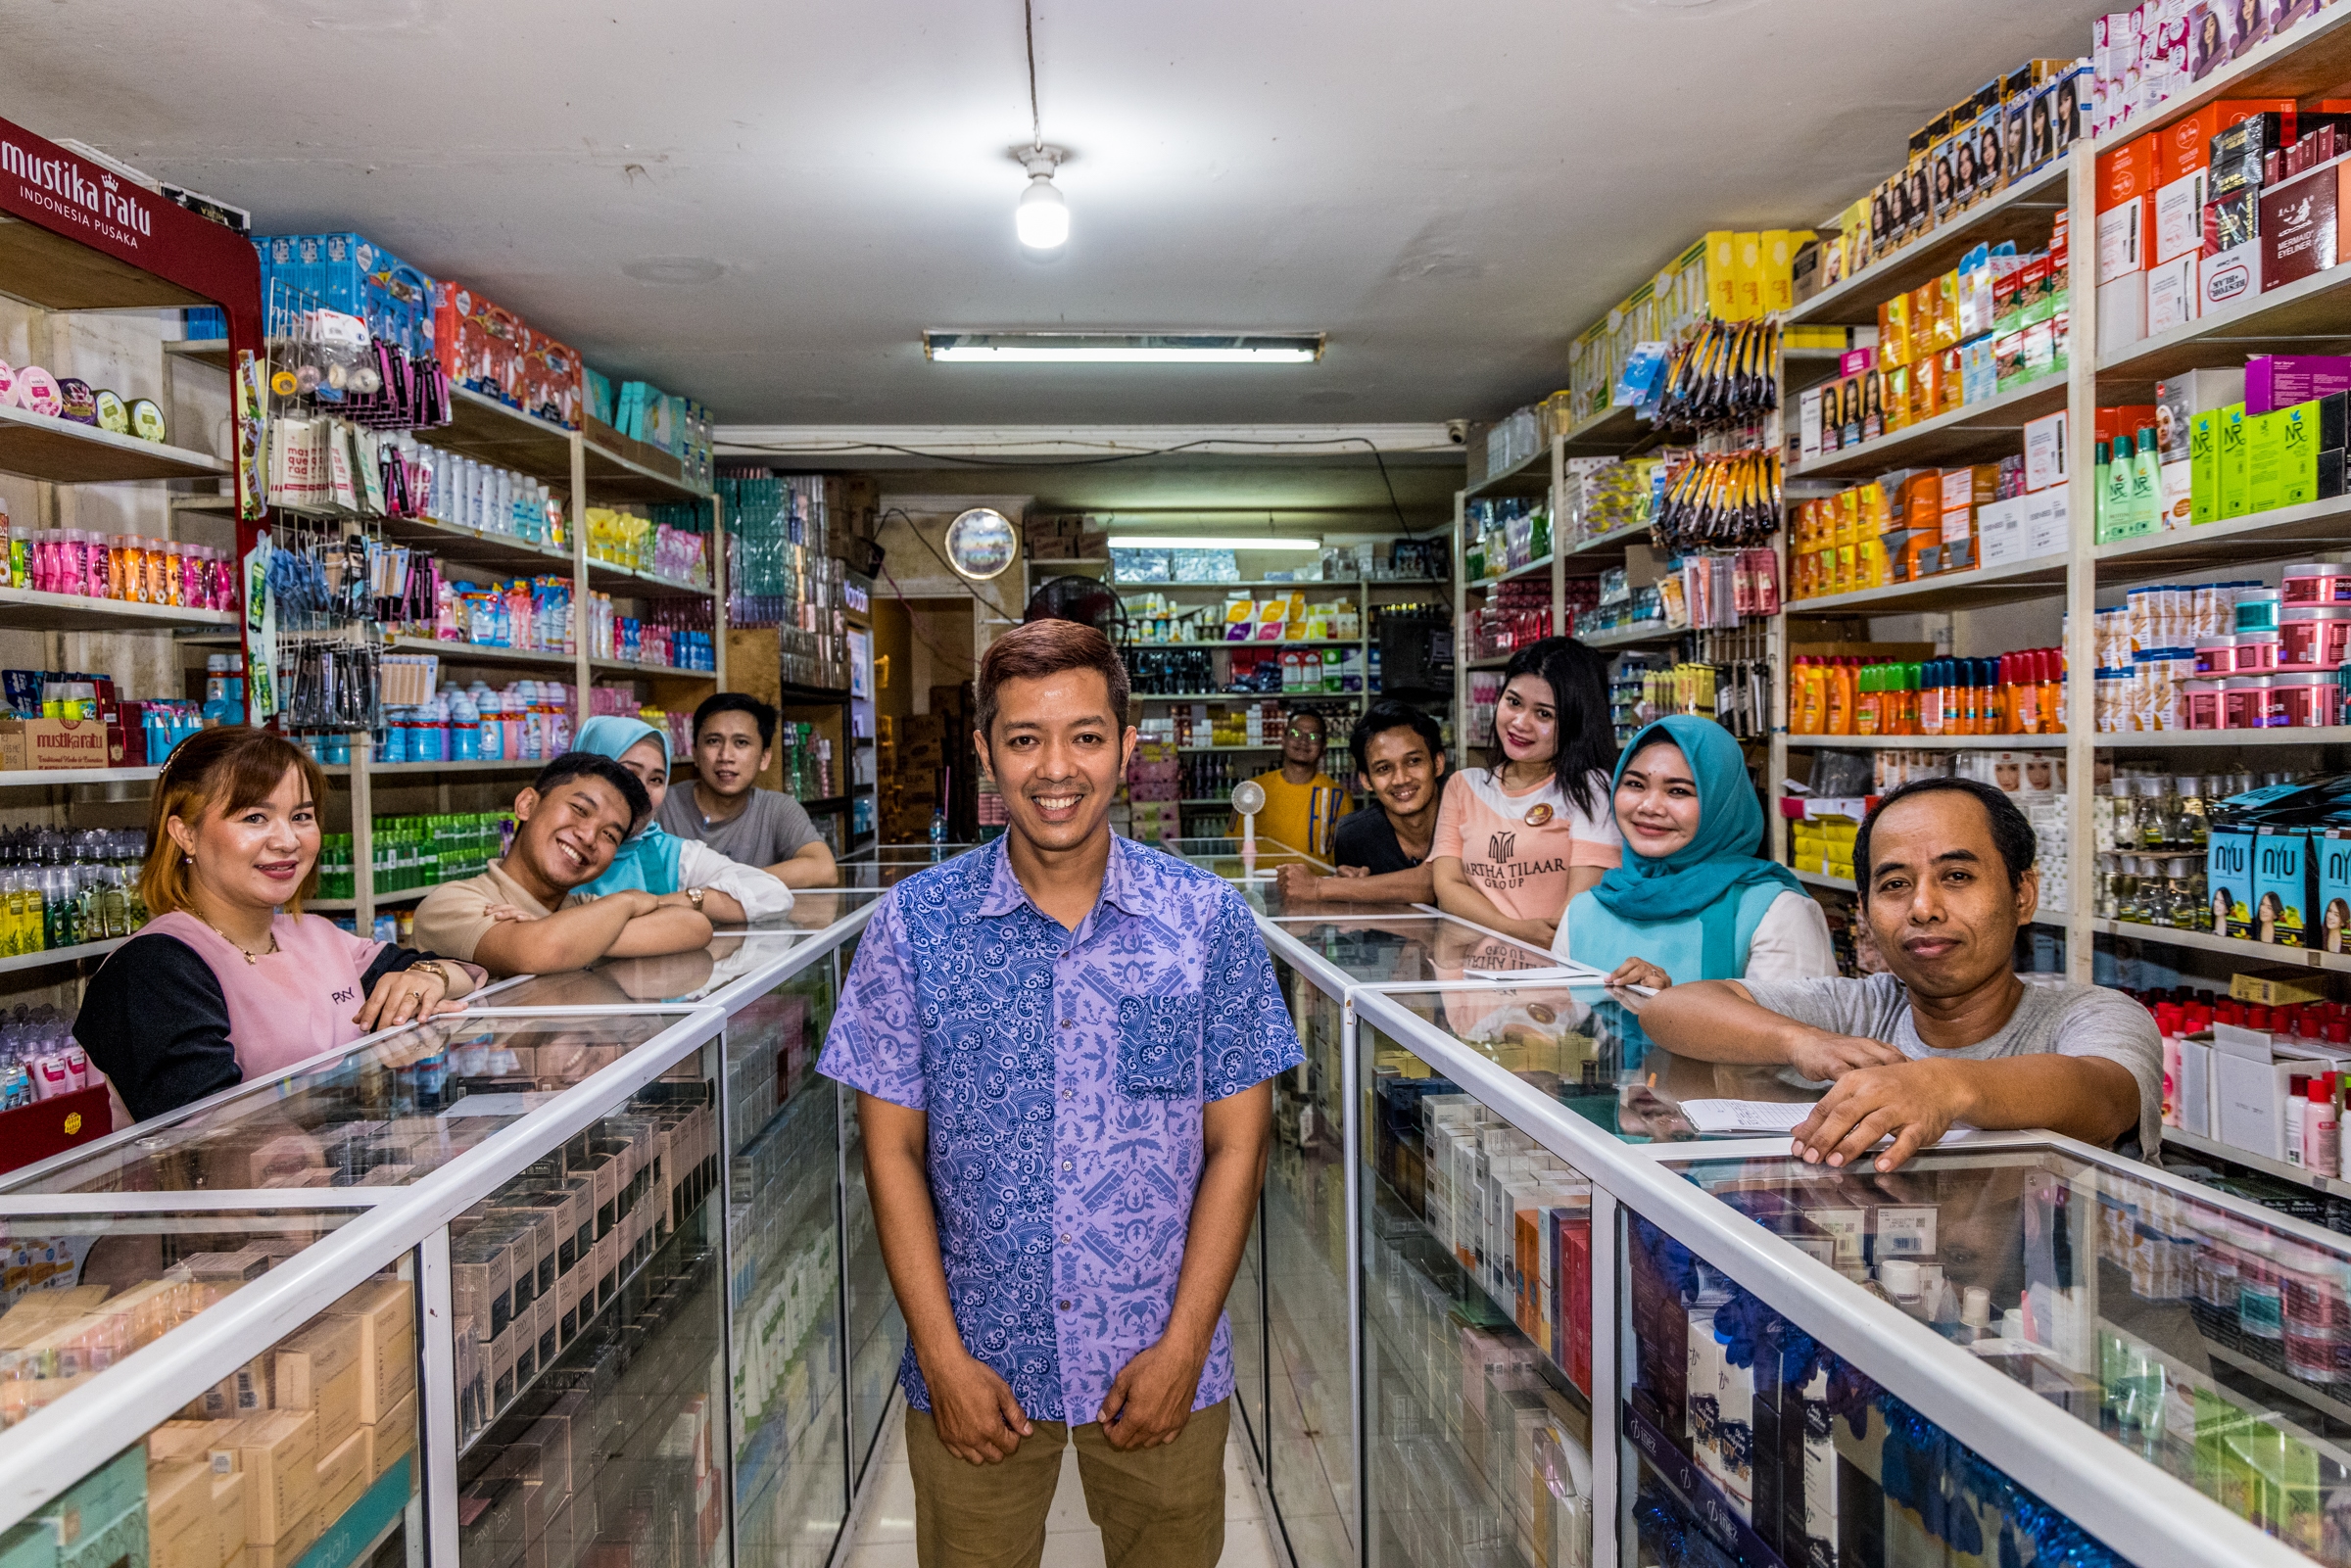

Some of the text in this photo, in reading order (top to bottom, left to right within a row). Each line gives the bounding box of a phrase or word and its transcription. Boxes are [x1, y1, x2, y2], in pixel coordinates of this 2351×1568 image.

[2, 141, 151, 237] mustika ratu
[20, 185, 138, 249] INDONESIA PUSAKA
[2278, 232, 2312, 250] MERMAID
[2278, 240, 2312, 259] EYELINER
[37, 733, 103, 749] mustika ratu
[1509, 858, 1566, 878] TILAAR
[1484, 879, 1524, 890] GROUP
[331, 986, 355, 1006] PIXY
[557, 1205, 568, 1218] PIXY
[514, 1242, 527, 1256] PIXY
[490, 1259, 503, 1274] PIXY
[1723, 1438, 1736, 1459] UV
